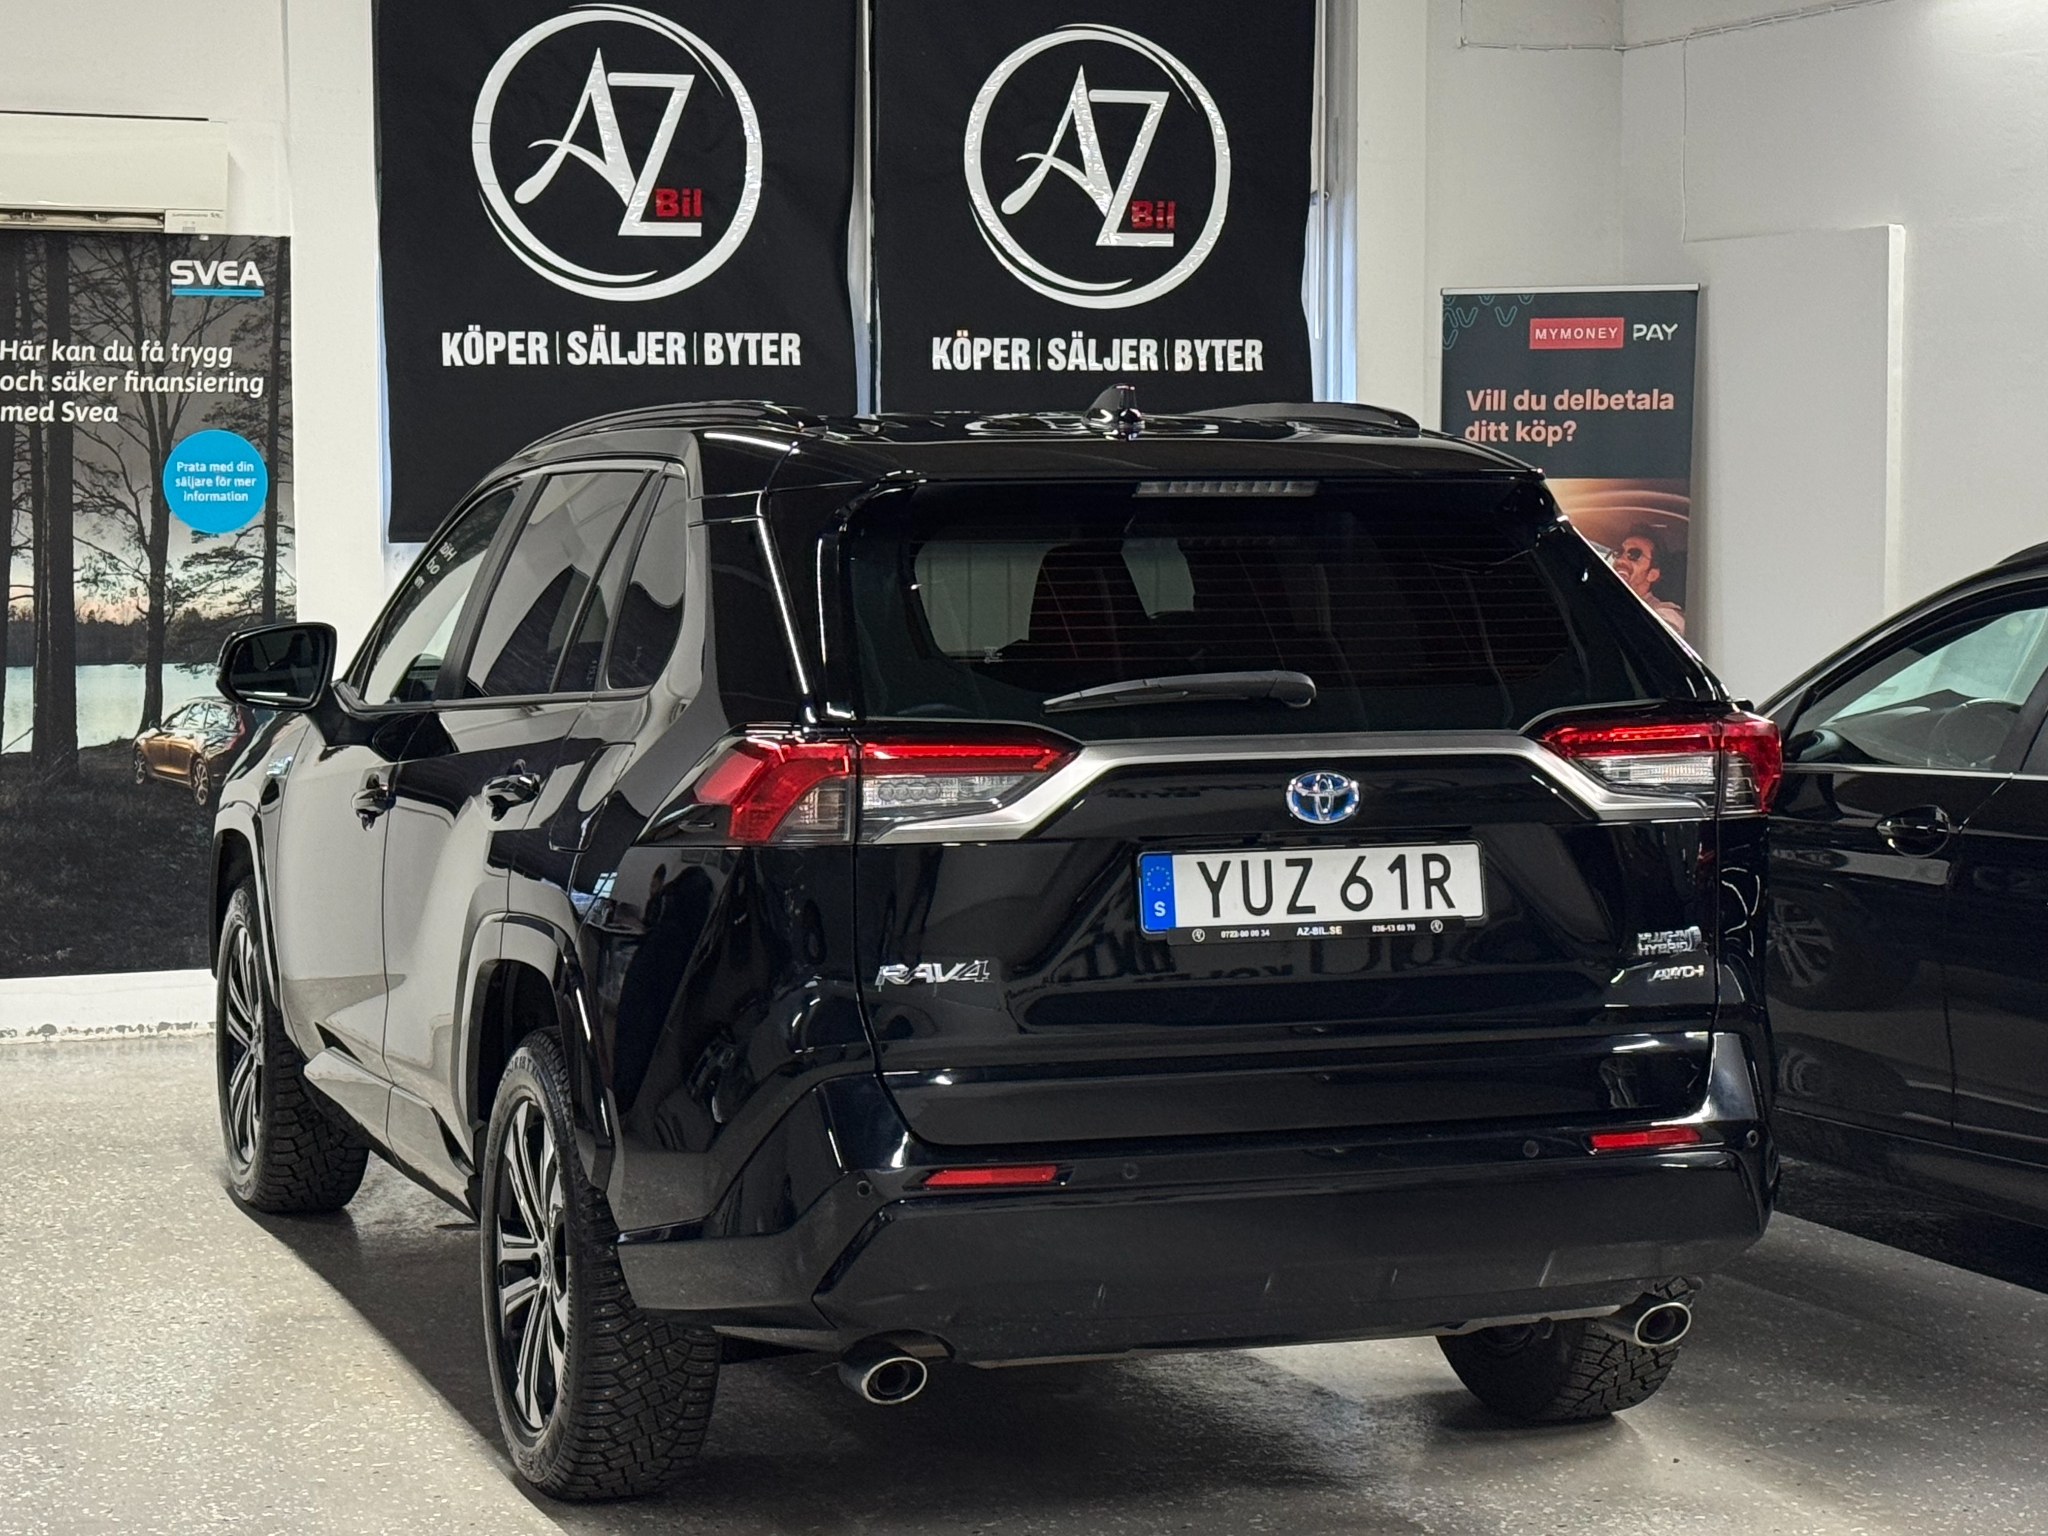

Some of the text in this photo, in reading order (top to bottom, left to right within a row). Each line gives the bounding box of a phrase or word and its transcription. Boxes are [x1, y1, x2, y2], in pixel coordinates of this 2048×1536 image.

[514, 48, 702, 237] AZ
[1001, 65, 1174, 247] AZ
[655, 188, 702, 217] Bil
[1131, 200, 1175, 229] Bil
[170, 260, 265, 286] SVEA
[441, 325, 801, 366] KÖPER SÄLJER BYTER
[1534, 323, 1679, 341] MYMONEY PAY
[0, 338, 233, 368] Här kan du få trygg
[932, 330, 1264, 372] KÖPER SÄLJER BYTER
[0, 369, 264, 398] och säker finansiering
[0, 399, 119, 422] med Svea
[1466, 388, 1675, 412] Vill du delbetala
[1464, 419, 1577, 447] ditt köp?
[176, 461, 254, 472] Prata med din
[175, 475, 257, 489] säljare för mer
[183, 490, 249, 502] information
[1196, 853, 1456, 918] YUZ 61R
[1154, 901, 1166, 917] S
[1296, 925, 1343, 937] AZ-BIL.SE
[874, 960, 991, 987] RAV4
